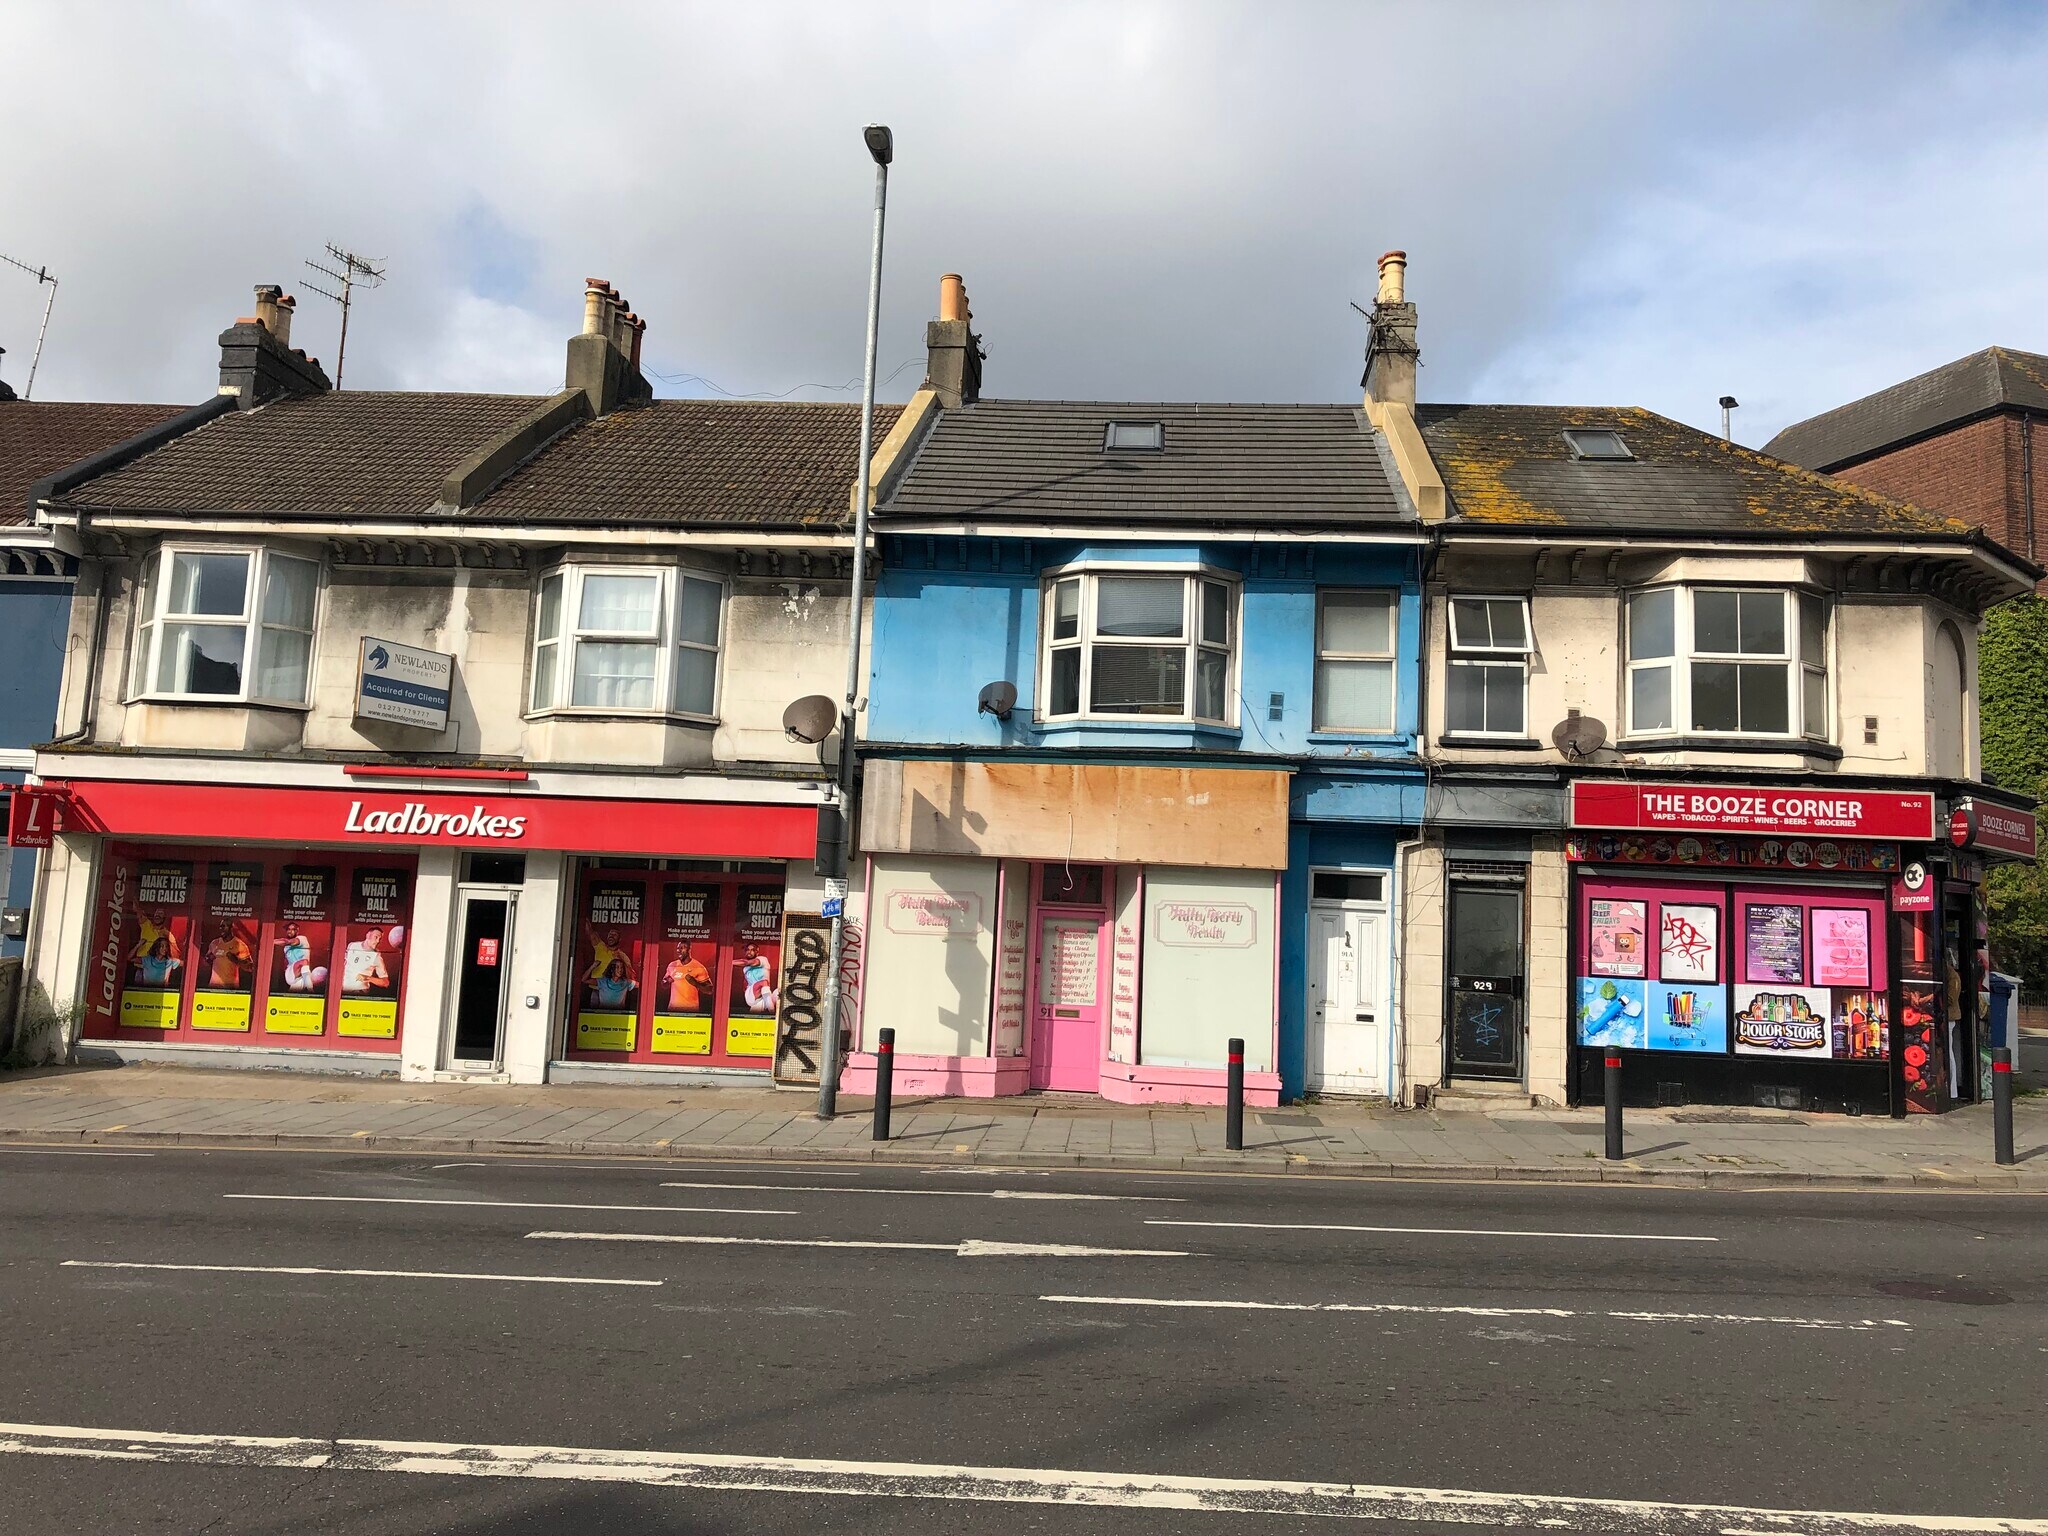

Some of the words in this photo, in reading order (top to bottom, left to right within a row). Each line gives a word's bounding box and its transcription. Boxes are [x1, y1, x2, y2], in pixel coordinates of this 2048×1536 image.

[394, 654, 447, 673] NEWLANDS
[402, 668, 436, 678] PROPERTY
[366, 682, 402, 696] Acquired
[418, 693, 445, 704] Clients
[378, 704, 401, 712] 01273
[368, 710, 438, 726] www.newlandsproperty.com
[1643, 794, 1685, 812] THE
[1692, 796, 1766, 815] BOOZE
[1772, 799, 1862, 818] CORNER
[27, 798, 40, 831] L
[344, 801, 527, 838] Ladbrokes
[1983, 815, 2002, 830] BOOZE
[2003, 820, 2026, 835] CORNER
[16, 835, 48, 844] Ladbrokes
[141, 875, 167, 888] MAKE
[170, 876, 187, 889] THE
[222, 878, 247, 890] BOOK
[291, 881, 314, 894] HAVE
[316, 882, 322, 894] A
[140, 889, 156, 902] BIG
[157, 890, 185, 903] CALLS
[362, 884, 389, 896] WHAT
[390, 884, 397, 897] A
[221, 892, 246, 904] THEM
[293, 895, 318, 908] SHOT
[367, 898, 388, 911] BALL
[593, 896, 620, 909] MAKE
[622, 896, 640, 910] THE
[1900, 896, 1929, 906] payzone
[677, 899, 704, 912] BOOK
[748, 901, 773, 913] HAVE
[775, 901, 781, 914] A
[592, 910, 608, 923] BIG
[610, 911, 639, 924] CALLS
[677, 913, 703, 926] THEM
[751, 915, 777, 928] SHOT
[96, 865, 126, 1017] Ladbrokes
[1041, 1007, 1051, 1017] 91
[1740, 1020, 1784, 1037] LIQUOR
[1785, 1024, 1822, 1040] STORE
